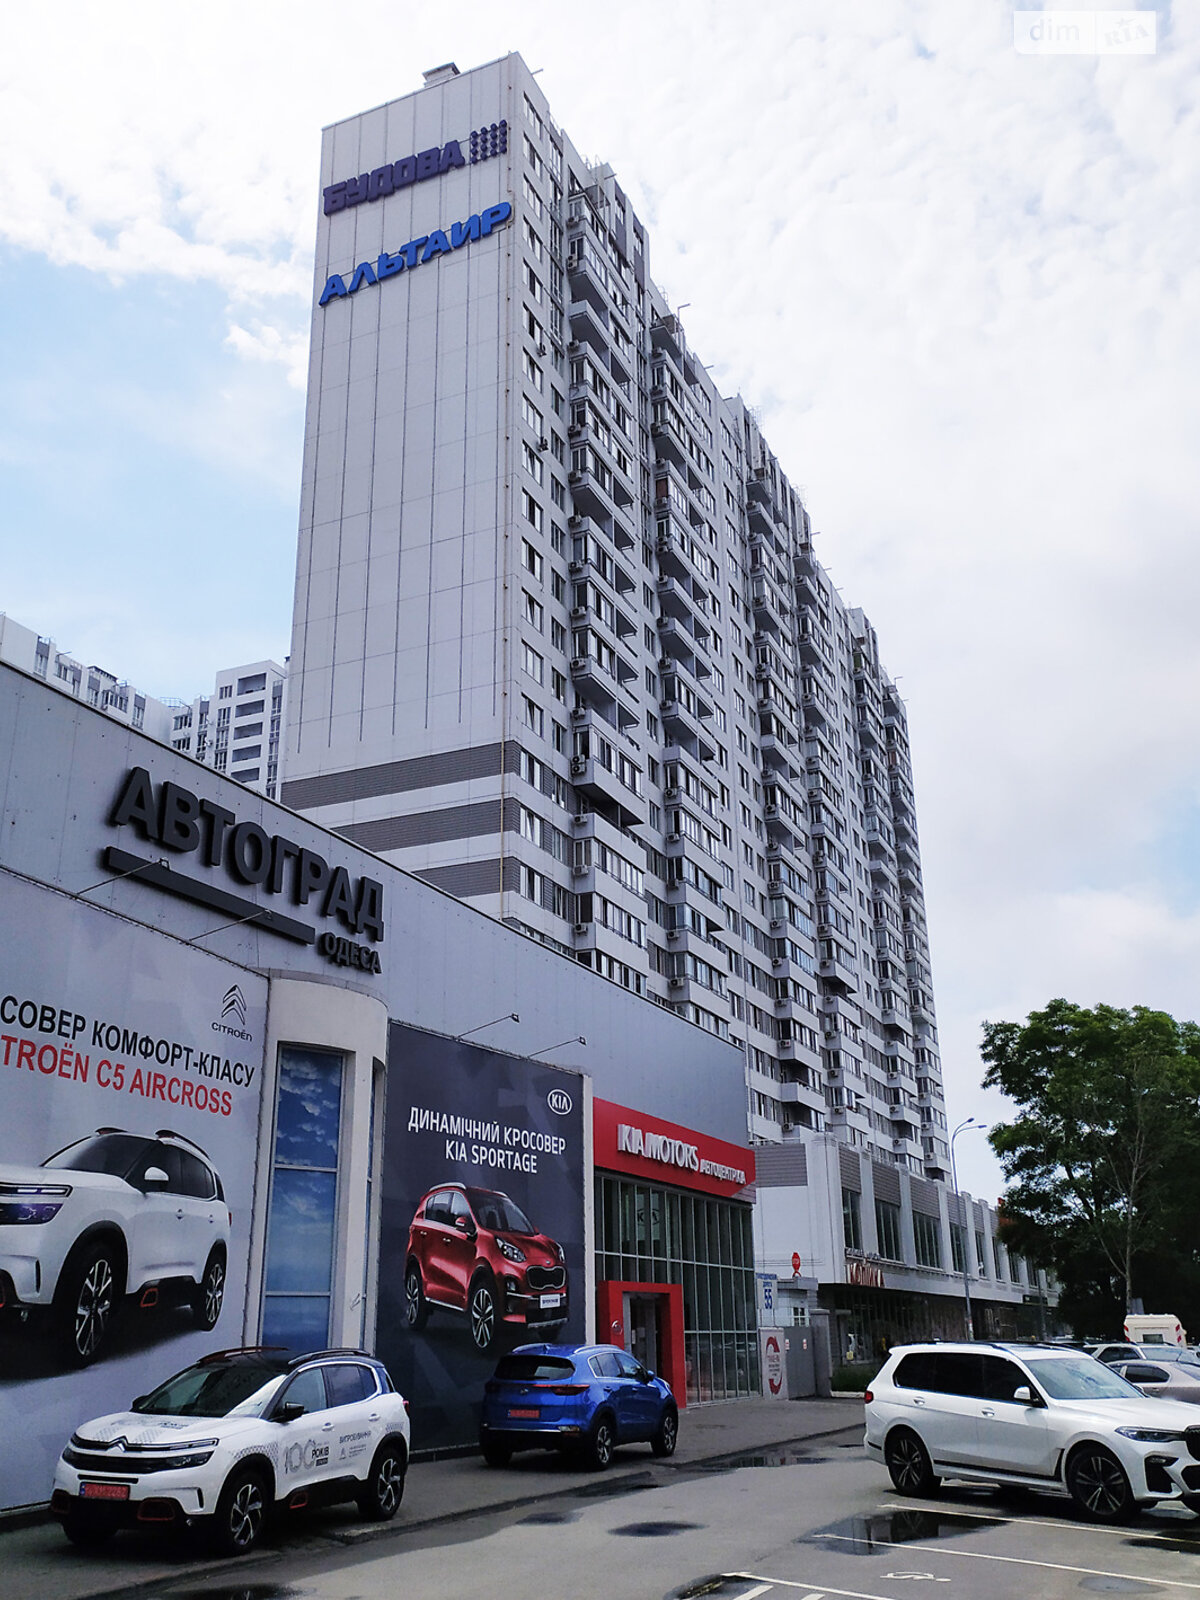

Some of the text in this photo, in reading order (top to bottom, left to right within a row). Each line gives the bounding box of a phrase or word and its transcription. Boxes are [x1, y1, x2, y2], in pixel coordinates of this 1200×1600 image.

[323, 140, 465, 216] БУДОВА
[319, 202, 512, 306] АЛЬТАИР
[112, 766, 384, 942] АВТОГРАД
[320, 932, 382, 974] ОДЕСА
[92, 1020, 255, 1088] КОМФОРТ-КЛАСУ
[96, 1059, 126, 1091] C5
[129, 1068, 233, 1117] AIRCROSS
[408, 1106, 566, 1156] ДИНАМІЧНИЙ КРОСОВЕР
[445, 1139, 538, 1174] KIA SPORTAGE
[644, 1132, 699, 1172] MOTORS
[764, 1288, 773, 1310] 55
